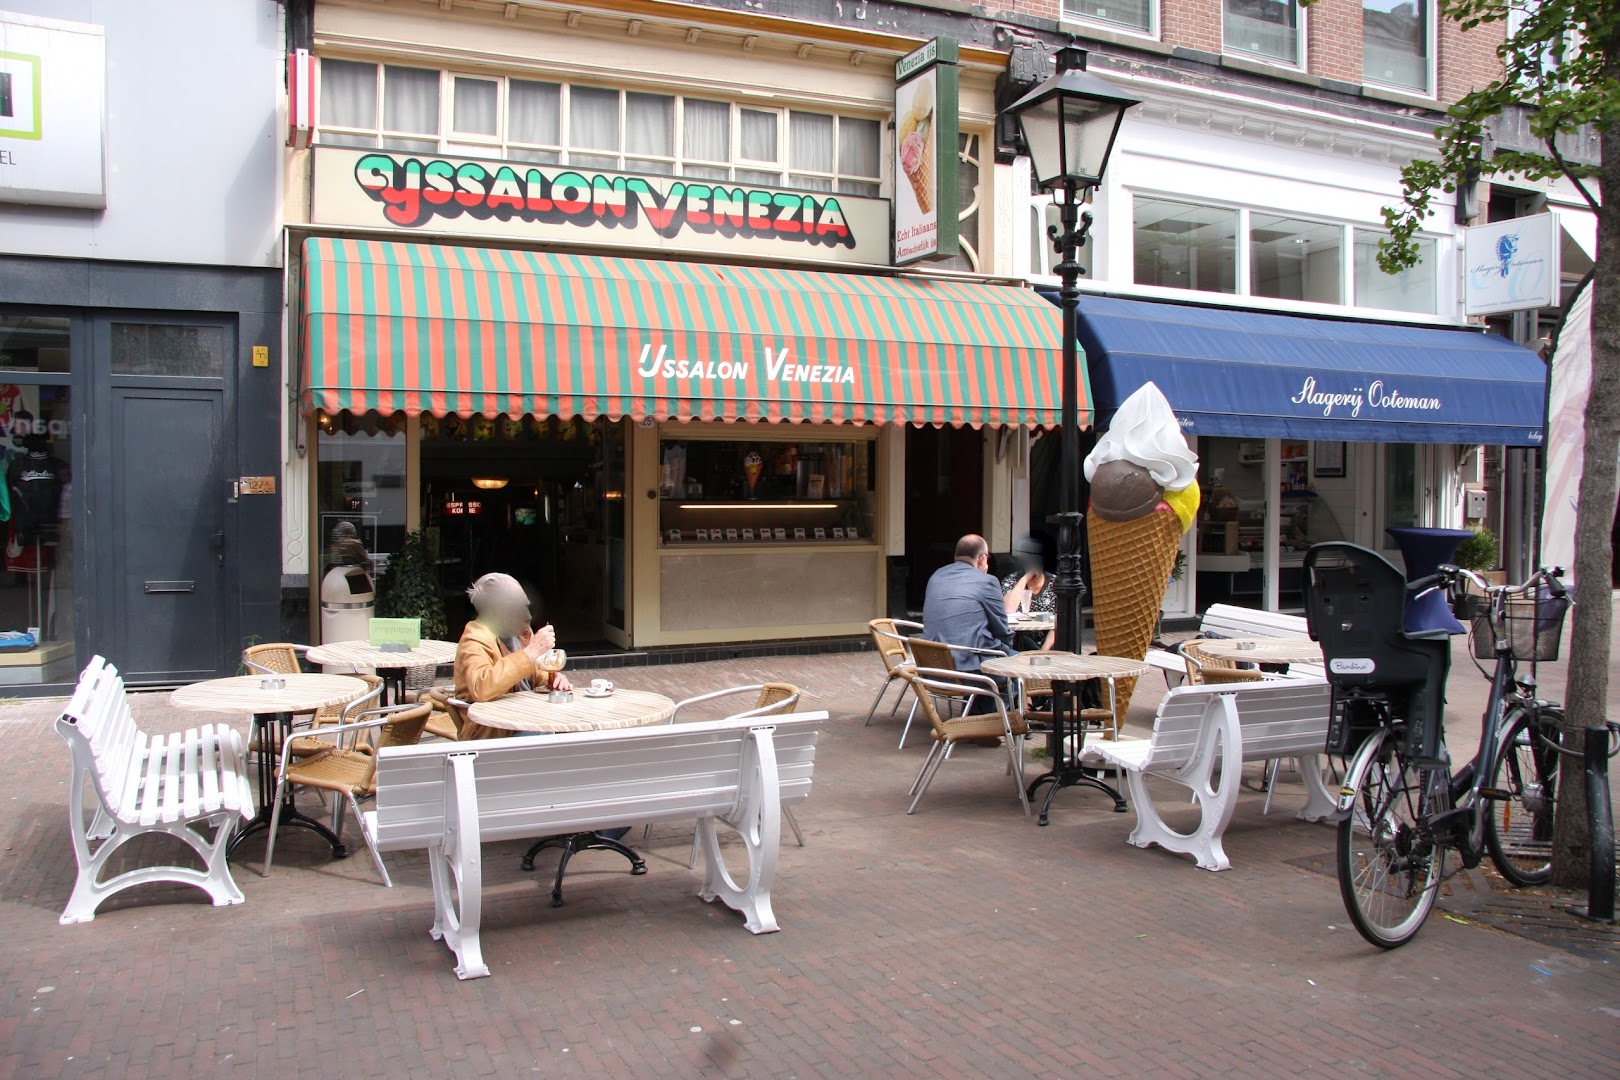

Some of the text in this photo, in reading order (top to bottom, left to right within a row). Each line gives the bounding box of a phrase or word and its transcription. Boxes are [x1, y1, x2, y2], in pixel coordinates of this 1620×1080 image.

[897, 52, 925, 75] Venezia
[626, 177, 856, 249] VENEZIA
[896, 222, 937, 242] Echt Italiaans
[1291, 376, 1441, 418] Slagerij Ooteman
